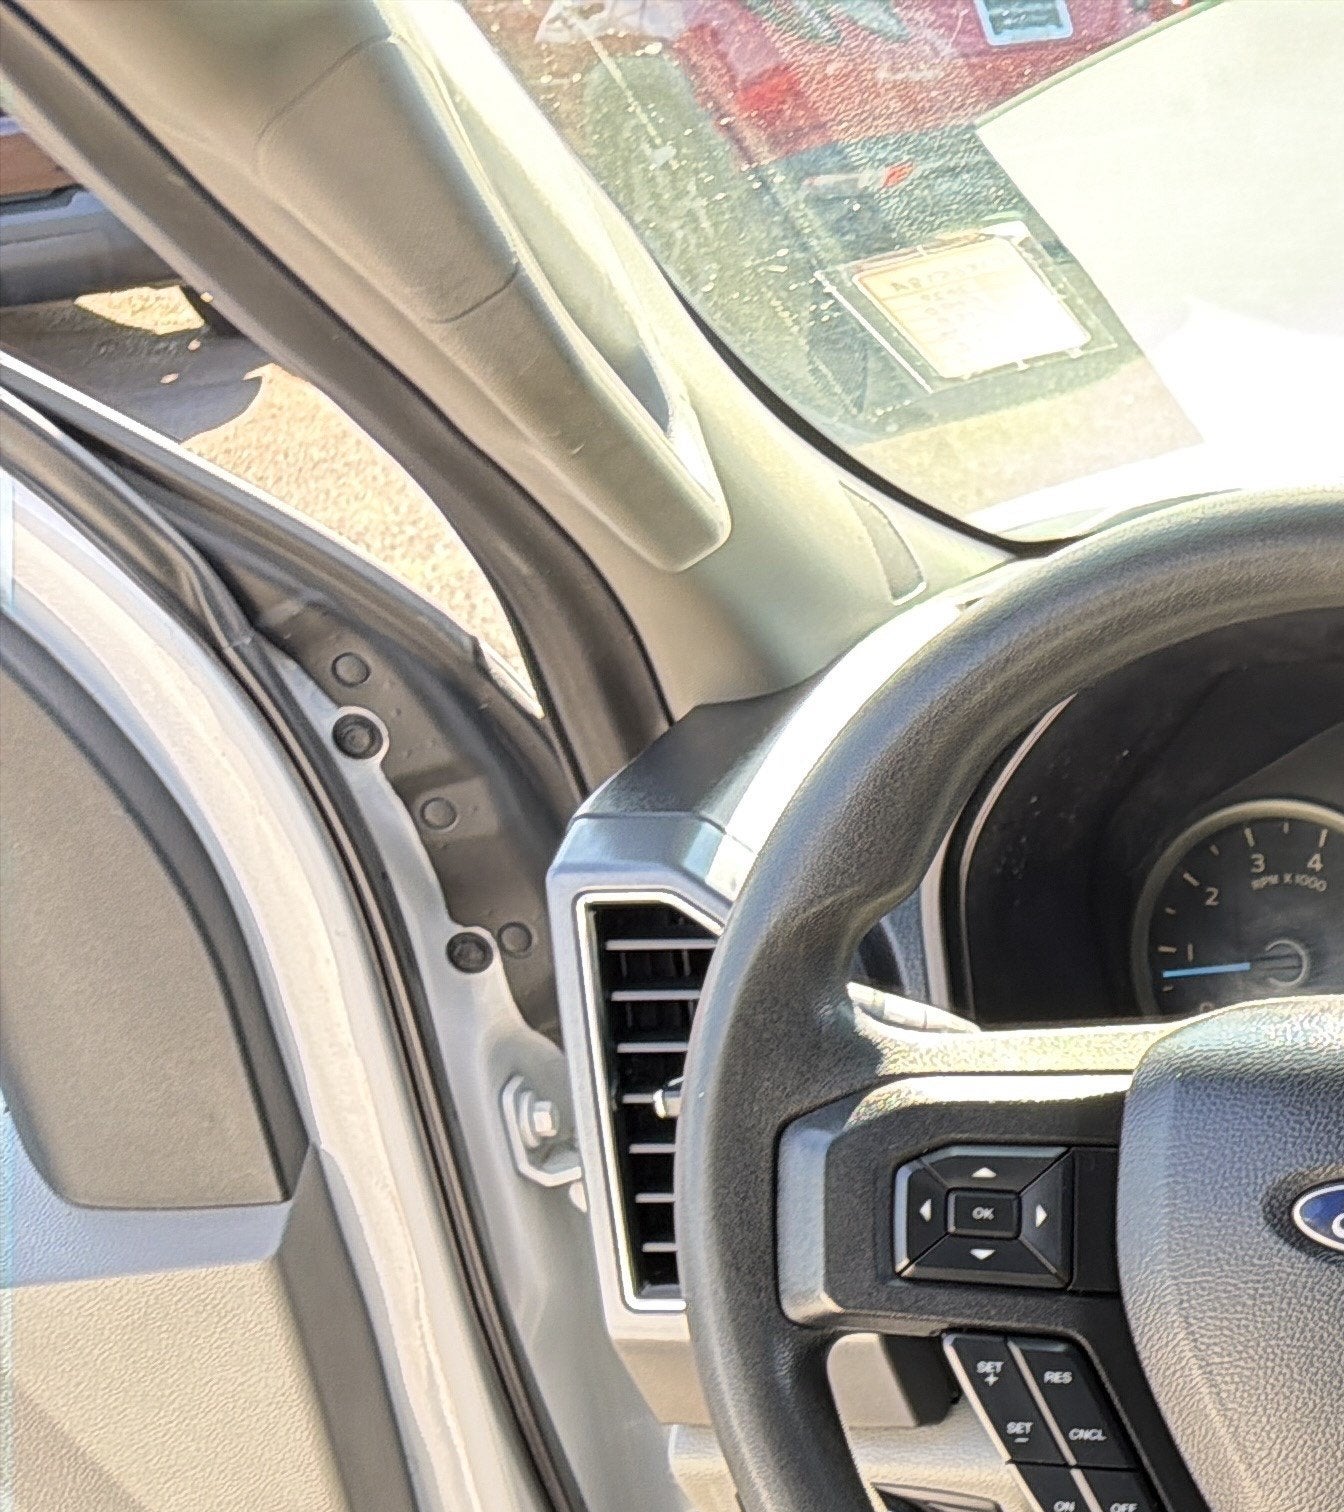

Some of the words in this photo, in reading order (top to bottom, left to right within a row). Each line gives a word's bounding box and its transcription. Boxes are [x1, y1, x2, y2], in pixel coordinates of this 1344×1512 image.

[1250, 853, 1266, 874] 3
[1306, 852, 1324, 873] 4
[1204, 887, 1220, 907] 2
[971, 1206, 995, 1221] OK
[976, 1360, 1005, 1374] SET
[1043, 1370, 1074, 1385] RES
[1006, 1421, 1034, 1435] SET
[1068, 1428, 1107, 1442] CNCL
